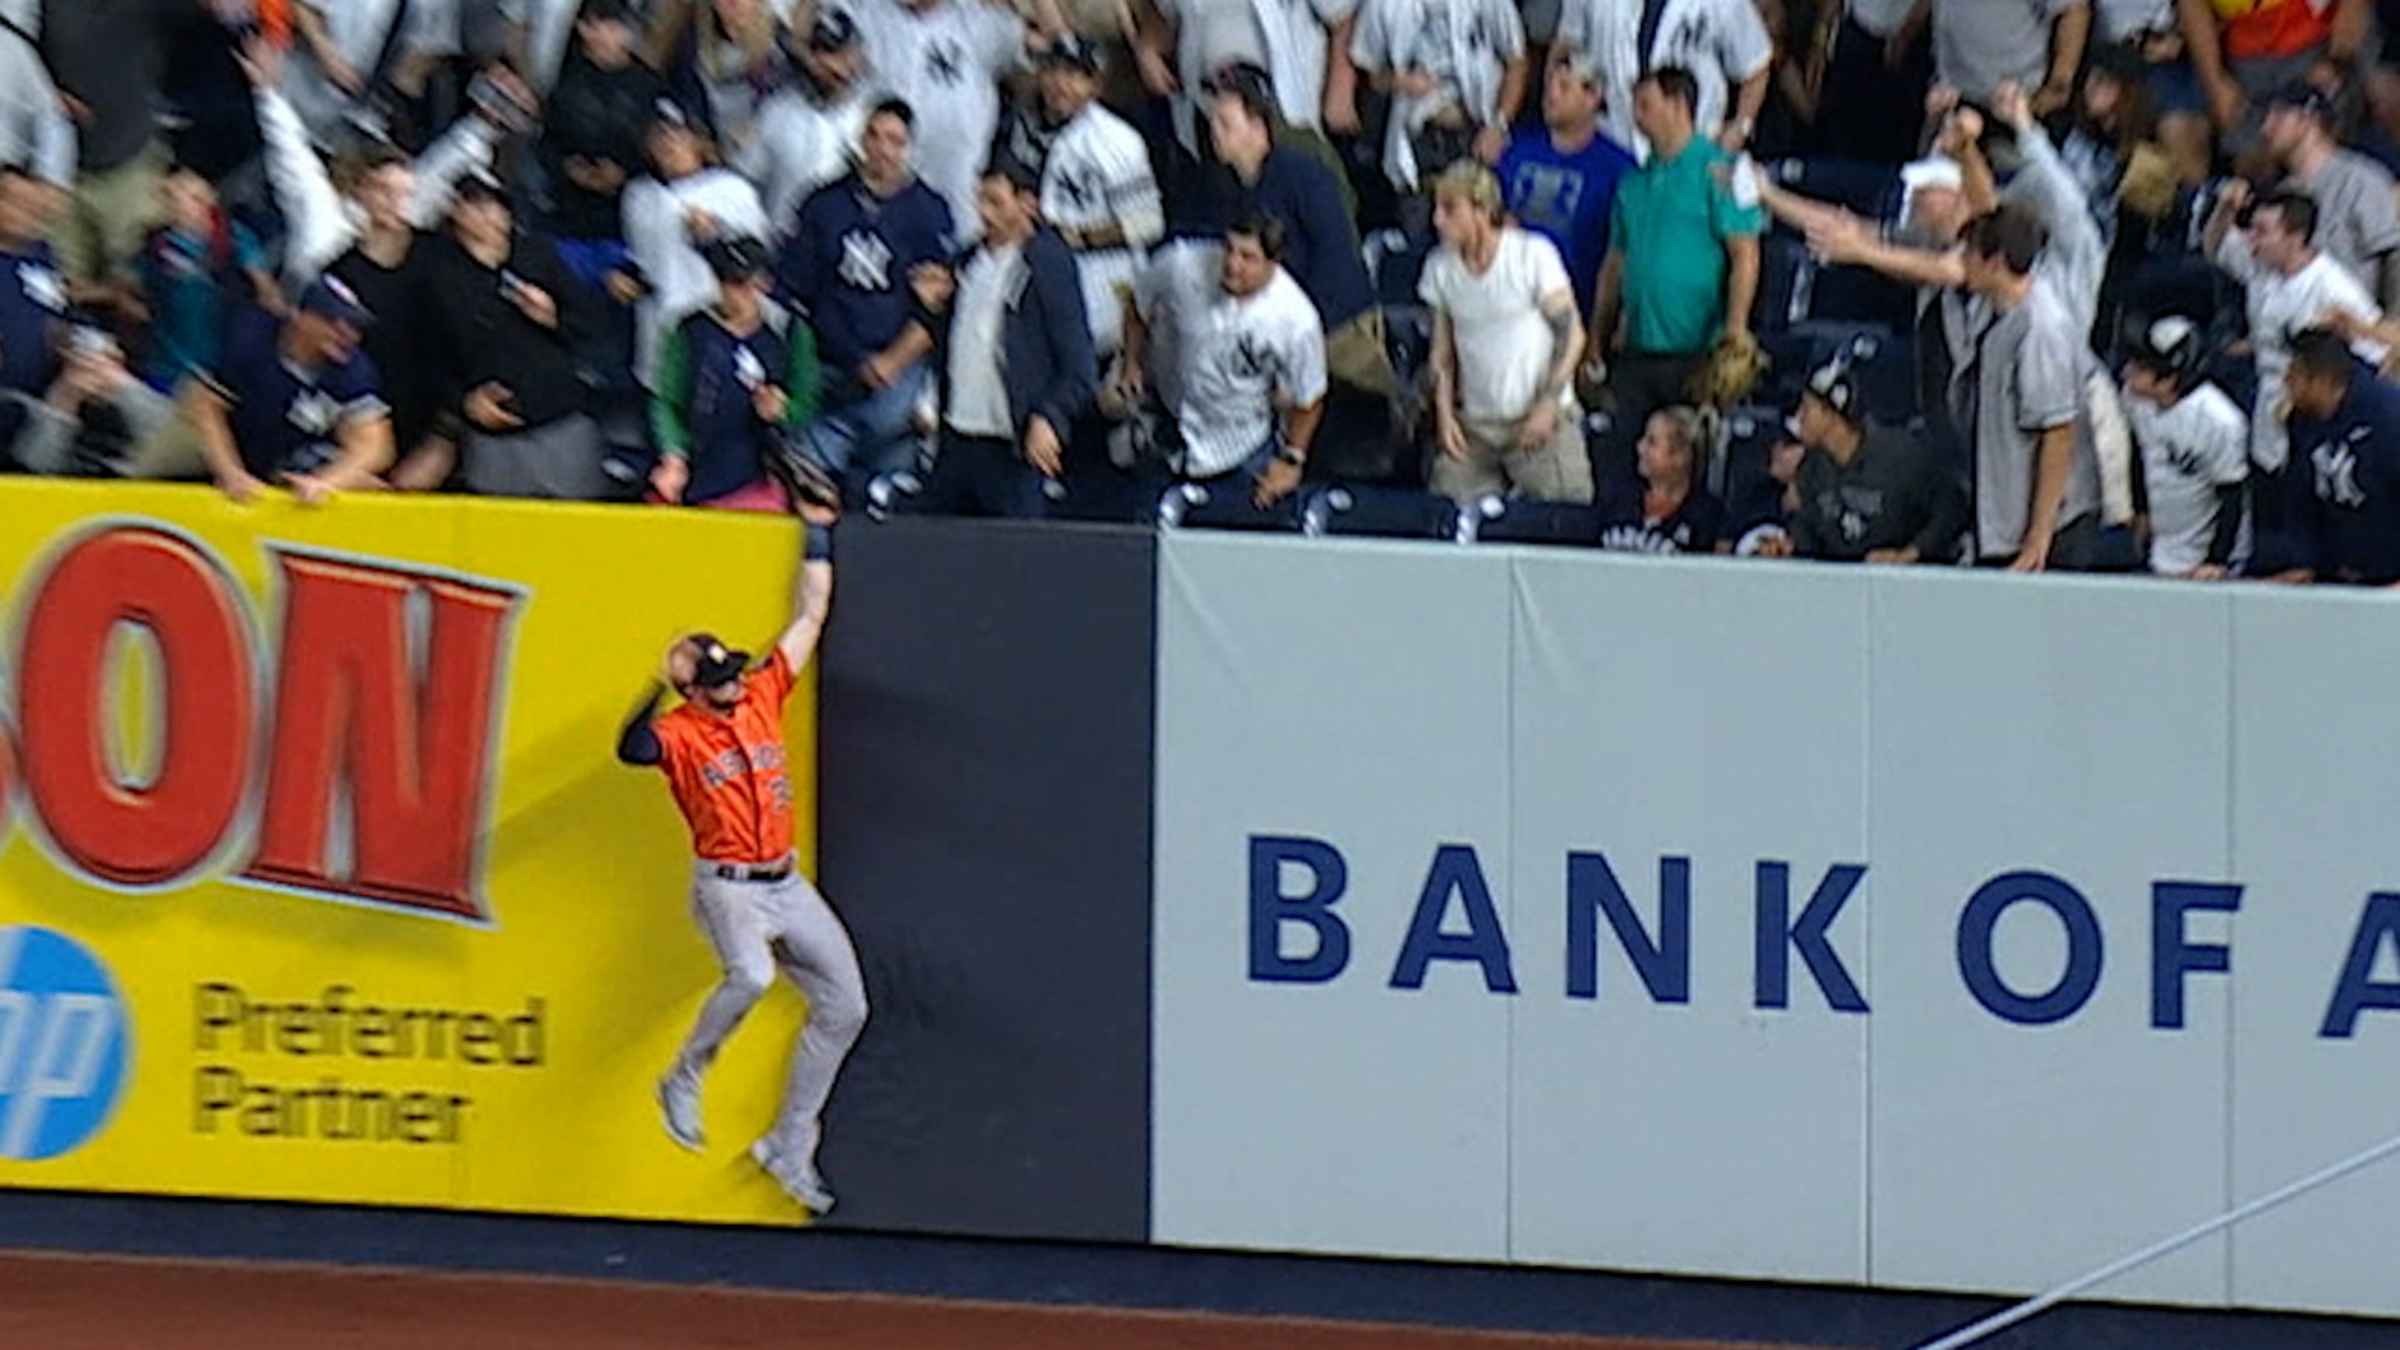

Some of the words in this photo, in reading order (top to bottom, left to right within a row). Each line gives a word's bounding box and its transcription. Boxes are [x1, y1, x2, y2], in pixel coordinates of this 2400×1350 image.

[0, 515, 530, 928] ON
[1247, 834, 1871, 1014] BANK
[1955, 869, 2246, 1031] OF
[195, 980, 545, 1066] Preferred
[195, 1064, 472, 1144] Partner
